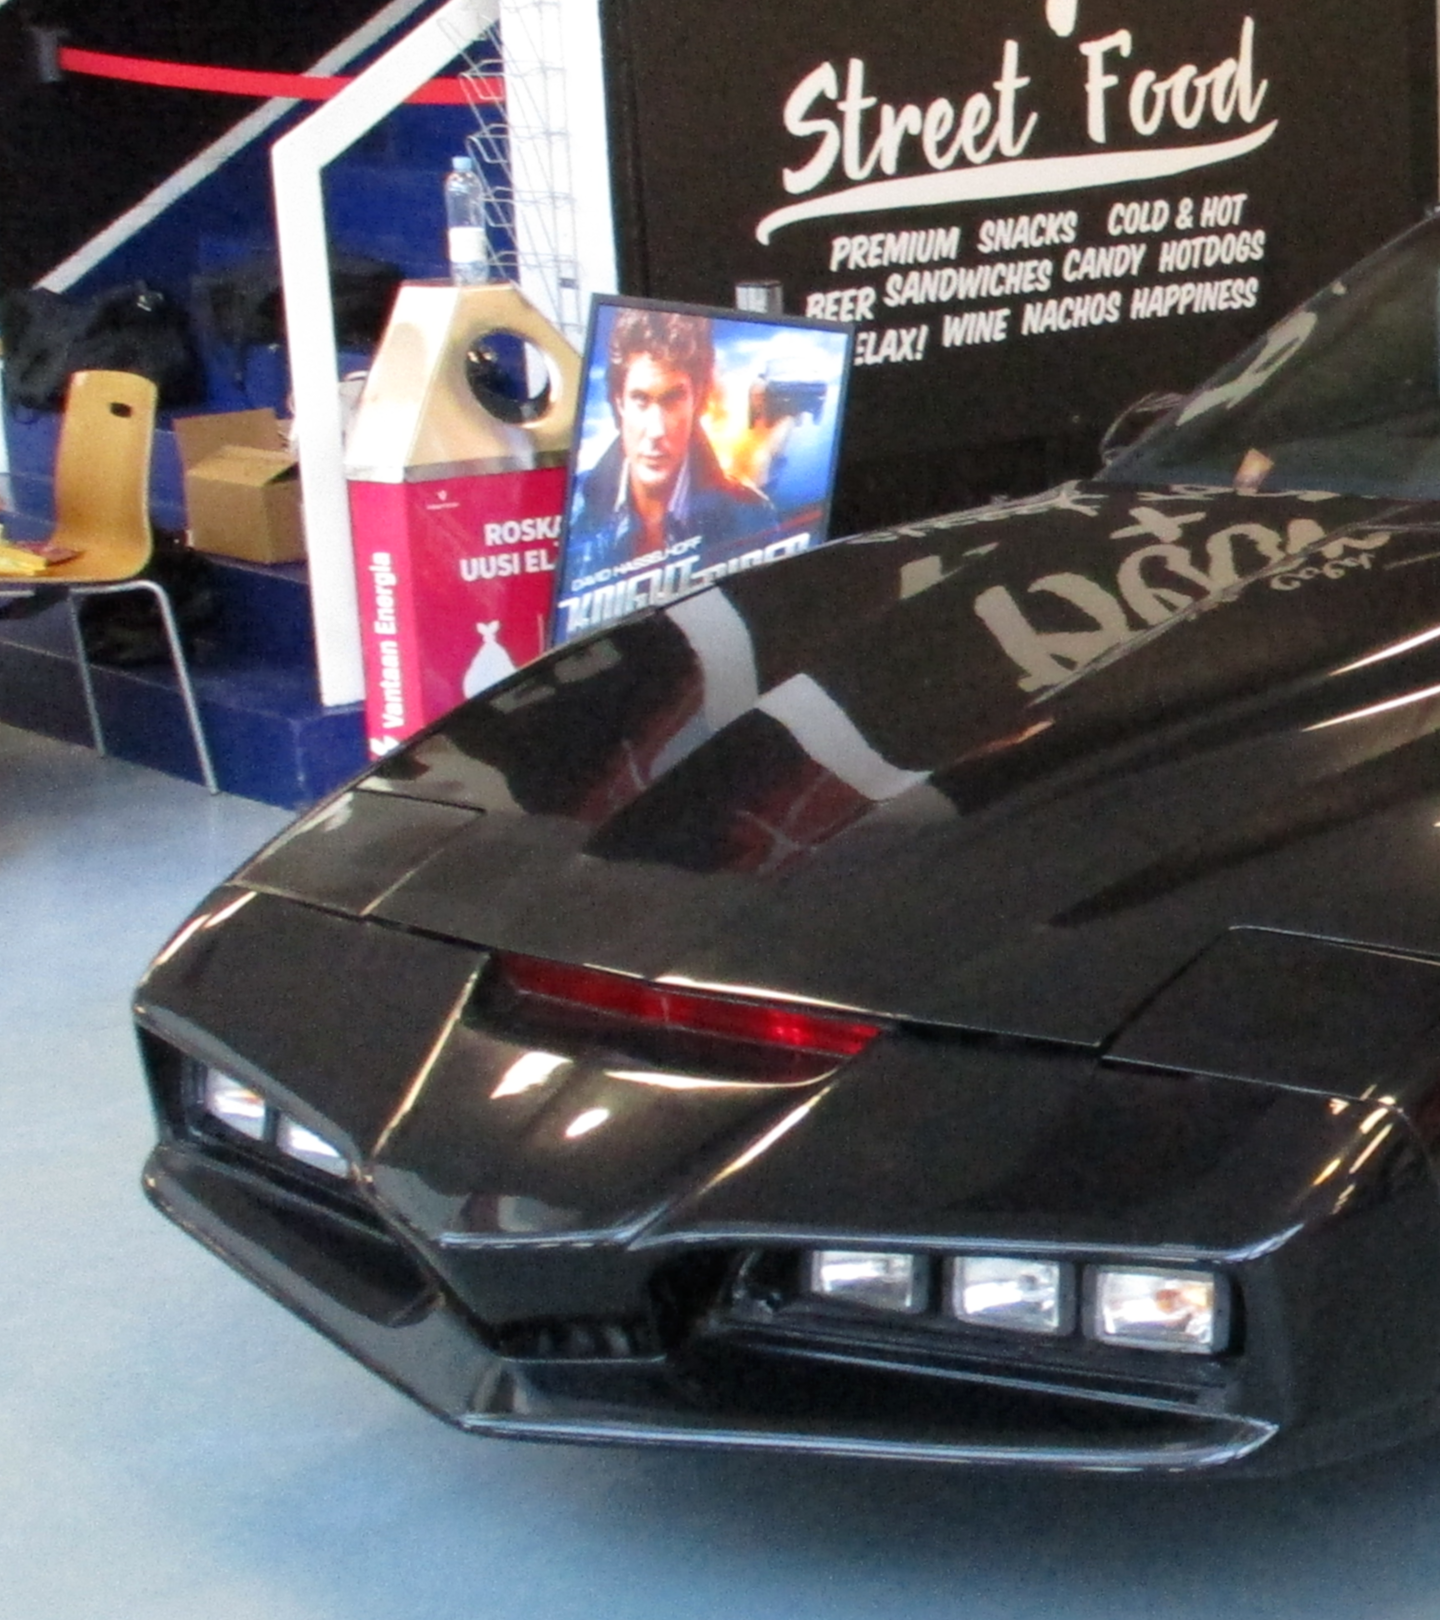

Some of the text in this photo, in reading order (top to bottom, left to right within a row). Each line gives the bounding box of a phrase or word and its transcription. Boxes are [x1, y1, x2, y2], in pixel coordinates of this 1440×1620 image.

[782, 15, 1269, 194] Street Food
[805, 229, 1266, 323] BEER SANDWICHES CANDY HOTDOGS
[829, 193, 1248, 272] PREMIUM SNACKS COLD & HOT
[854, 277, 1259, 367] ELAX! WINE NACHOS HAPPINESS
[461, 547, 558, 581] UUSI EL
[571, 536, 703, 592] DAVID HASSELHOFF
[369, 551, 405, 729] Vantaan Energia
